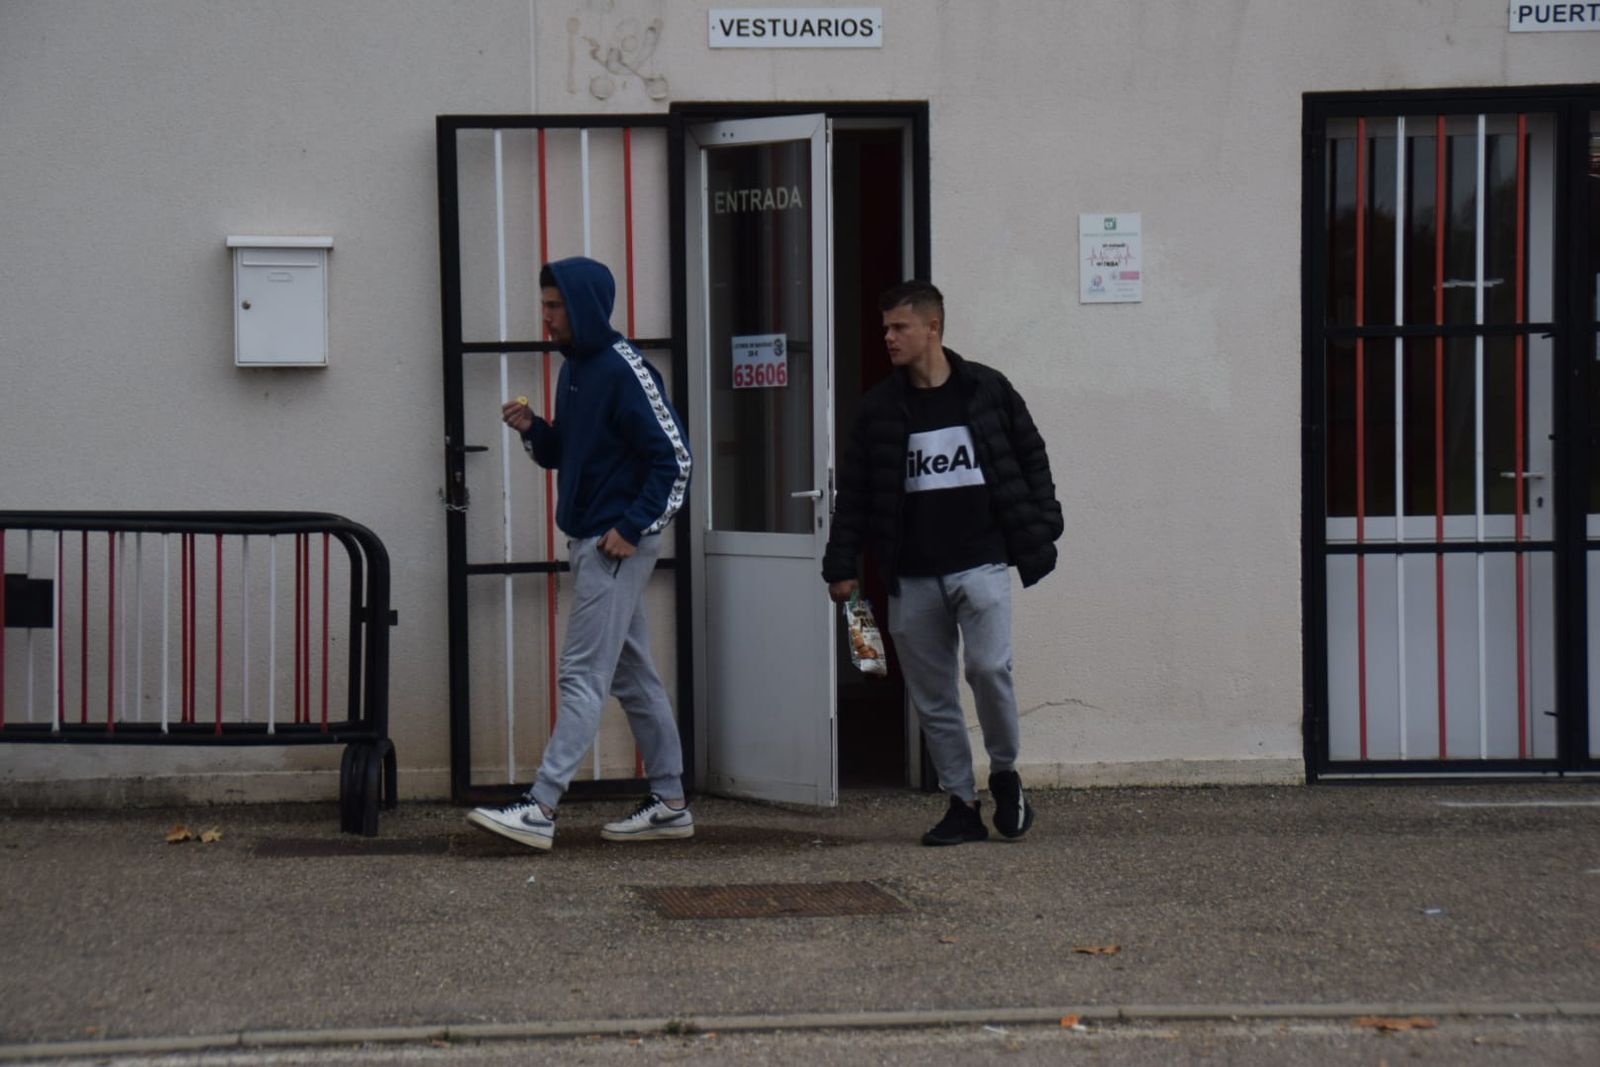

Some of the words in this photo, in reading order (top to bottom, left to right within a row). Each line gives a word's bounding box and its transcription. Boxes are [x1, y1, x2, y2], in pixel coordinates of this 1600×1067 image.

[1518, 3, 1600, 24] PUERT
[719, 18, 874, 37] VESTUARIOS
[714, 185, 803, 214] ENTRADA
[734, 361, 786, 387] 63606
